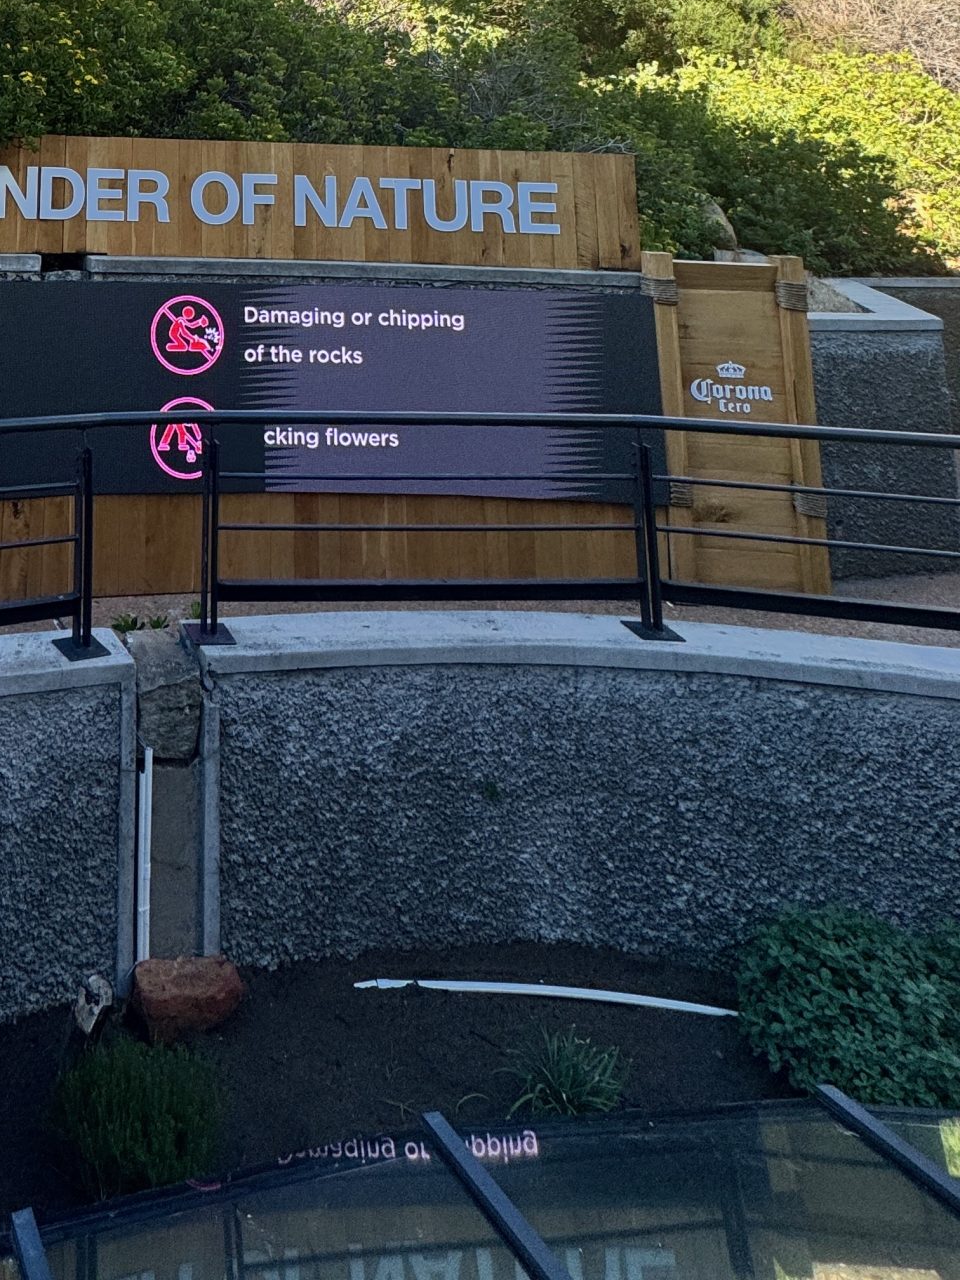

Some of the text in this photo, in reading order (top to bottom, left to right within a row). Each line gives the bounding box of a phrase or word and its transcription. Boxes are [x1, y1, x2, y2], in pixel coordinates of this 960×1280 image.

[190, 170, 278, 225] OF
[294, 174, 561, 235] NATURE
[244, 306, 465, 331] Damaging or chipping
[244, 344, 363, 364] of the rocks
[690, 378, 773, 405] Corona
[263, 427, 399, 448] cking flowers
